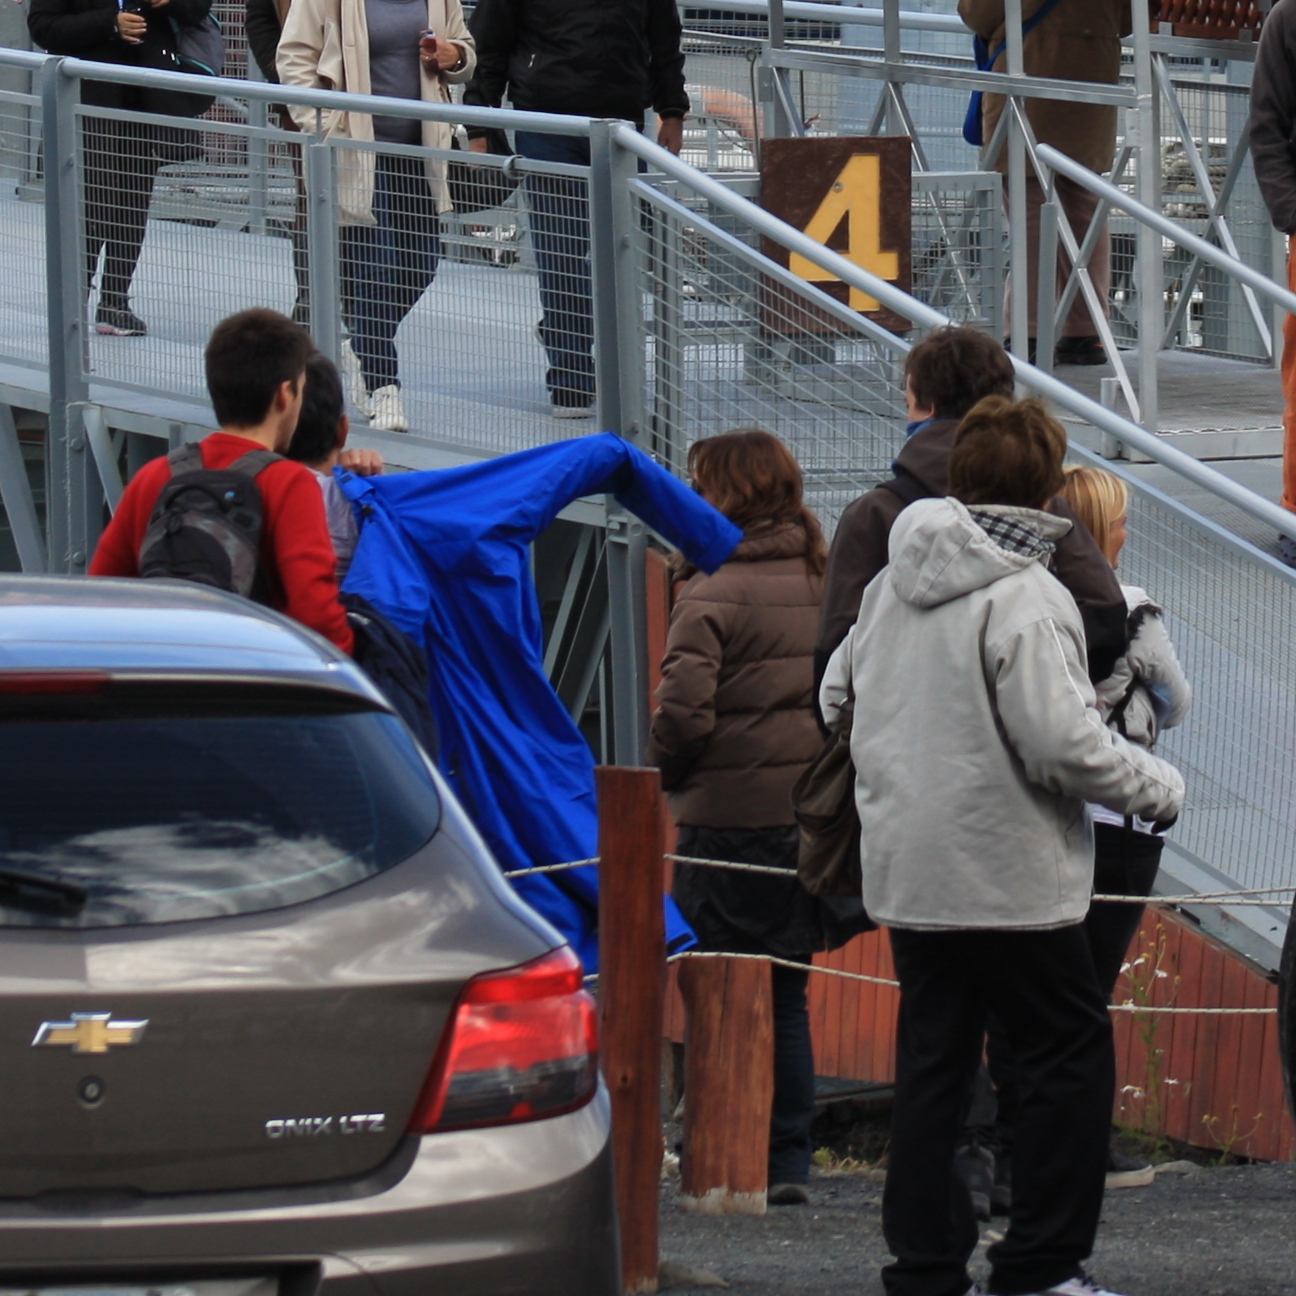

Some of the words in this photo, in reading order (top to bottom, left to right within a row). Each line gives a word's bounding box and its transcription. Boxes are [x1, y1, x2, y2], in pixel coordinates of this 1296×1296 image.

[789, 153, 899, 311] 4
[265, 1116, 333, 1139] ONIX
[339, 1113, 386, 1135] LTZ
